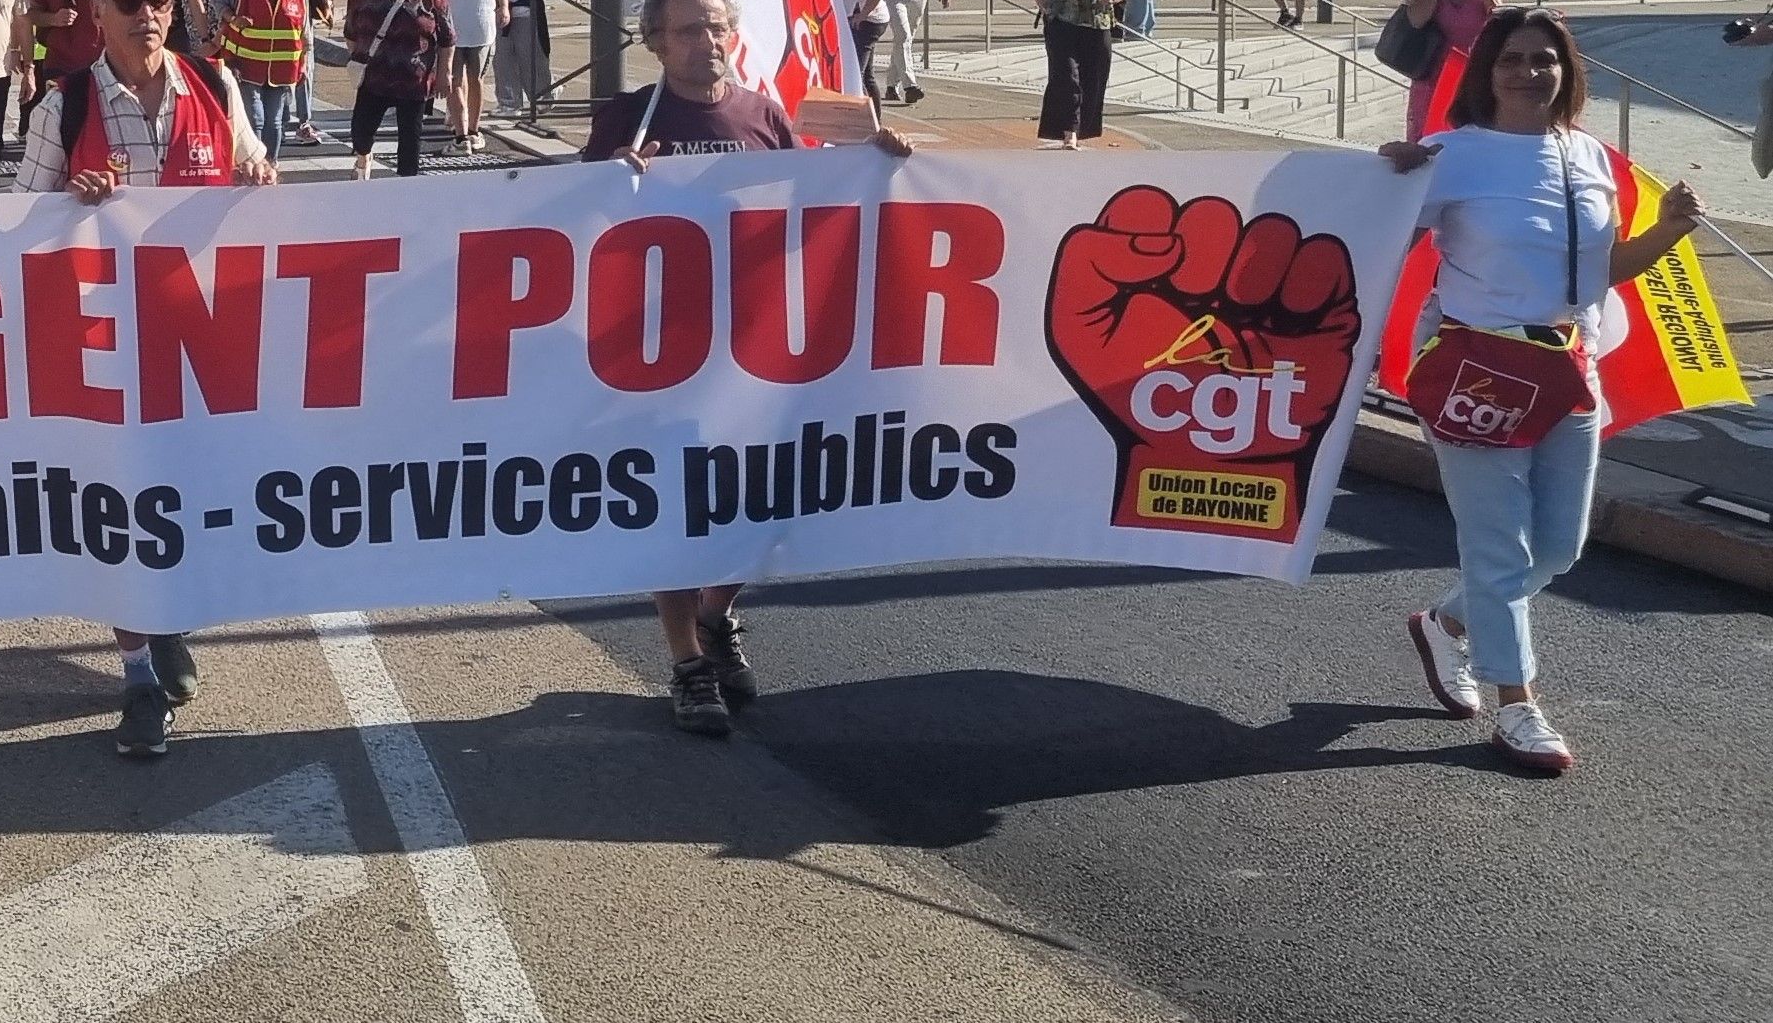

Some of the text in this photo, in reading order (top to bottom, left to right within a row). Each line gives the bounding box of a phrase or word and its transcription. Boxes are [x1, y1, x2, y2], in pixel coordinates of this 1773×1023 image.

[452, 201, 1005, 400] POUR
[1130, 361, 1305, 454] cgt
[255, 442, 659, 553] services
[683, 412, 1017, 538] publics
[1148, 474, 1277, 501] Union Locale
[1152, 495, 1269, 523] de BAYONNE
